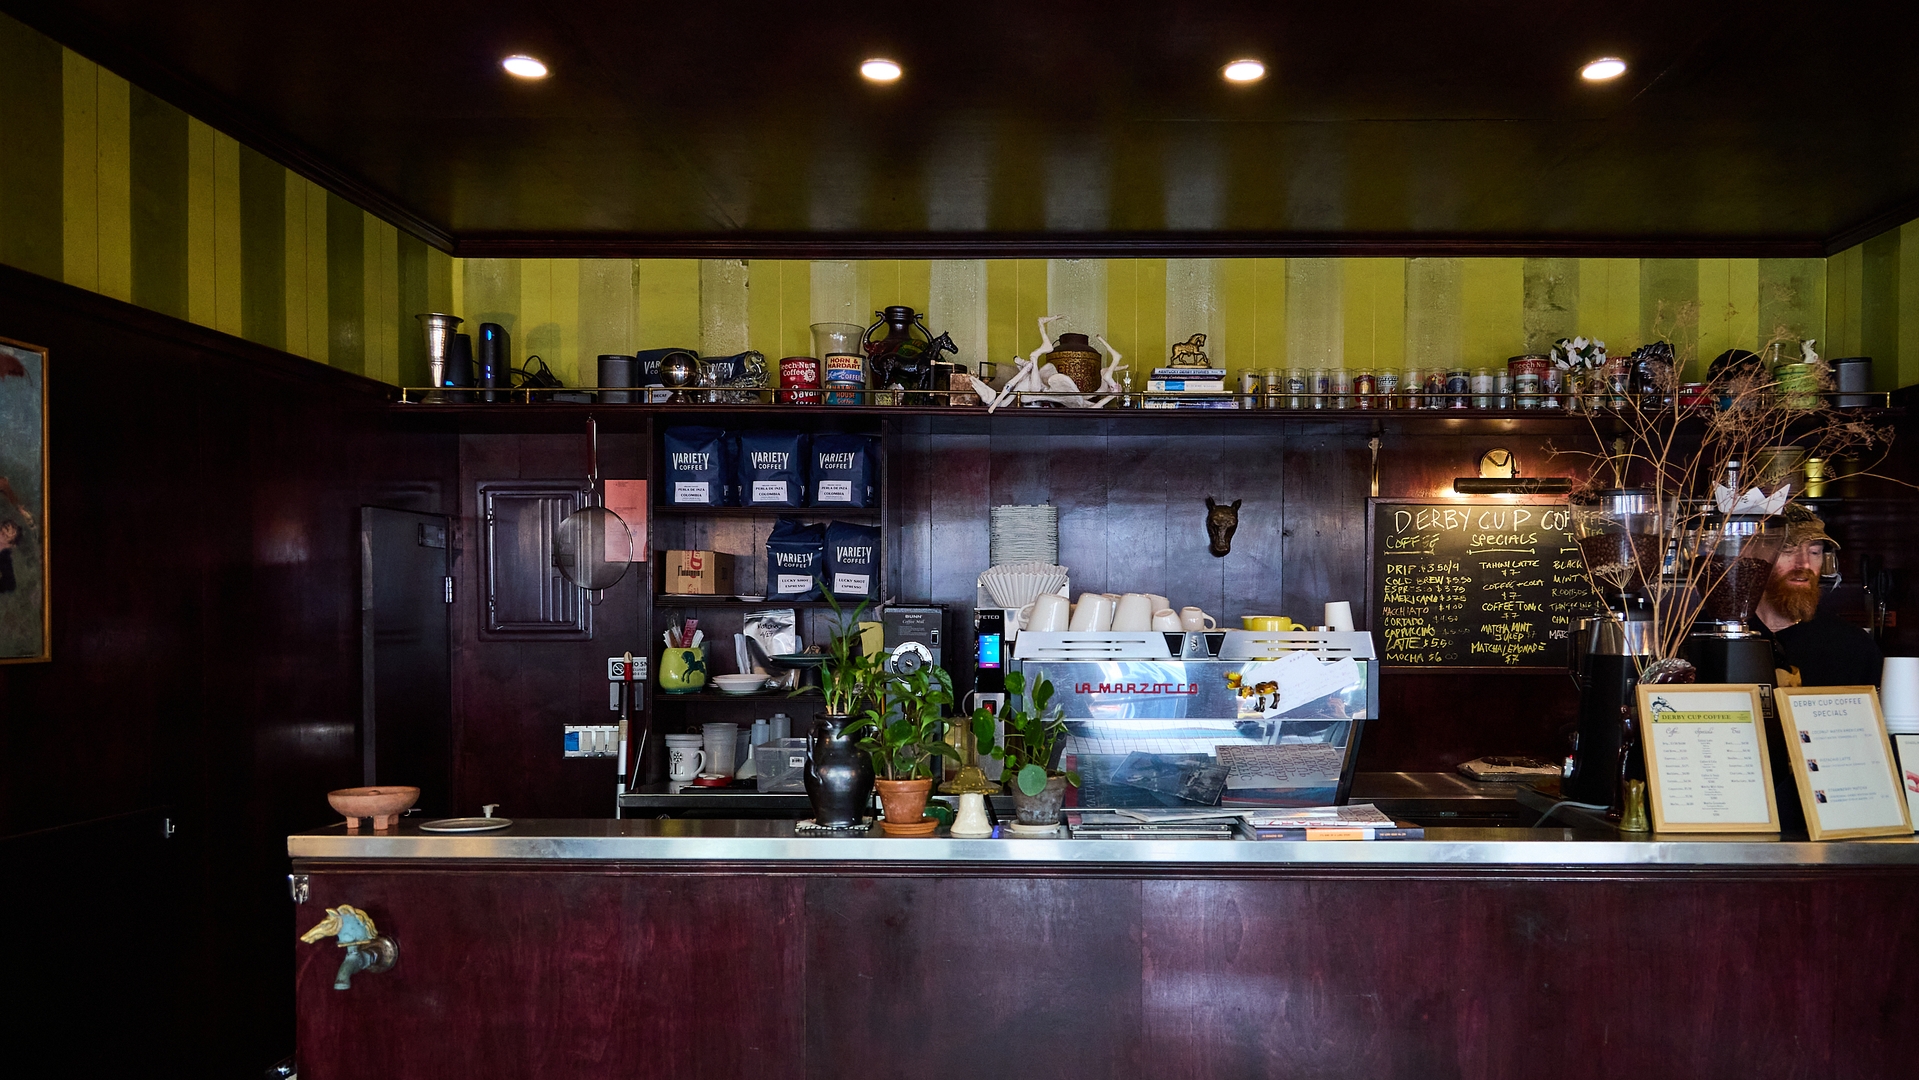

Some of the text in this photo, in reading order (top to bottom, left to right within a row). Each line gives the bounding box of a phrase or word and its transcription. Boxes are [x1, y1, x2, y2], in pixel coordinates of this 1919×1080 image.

[782, 368, 805, 376] Coffee
[672, 452, 710, 470] VARIETY
[751, 452, 789, 470] VARIETY
[820, 452, 855, 469] VARIETY
[1394, 508, 1472, 534] DERBY
[1478, 509, 1532, 531] CUP
[1470, 532, 1538, 547] SPECIALS
[776, 552, 813, 567] VARIETY
[836, 546, 872, 563] VARIETY
[1553, 560, 1583, 570] BLACK
[1554, 574, 1580, 583] MINT
[1482, 602, 1514, 612] COFFEE
[1384, 617, 1424, 627] CORTADO
[1552, 616, 1569, 624] CHAI
[1385, 637, 1423, 651] LATTE
[1386, 653, 1424, 663] MOCHA
[1075, 683, 1091, 694] LA
